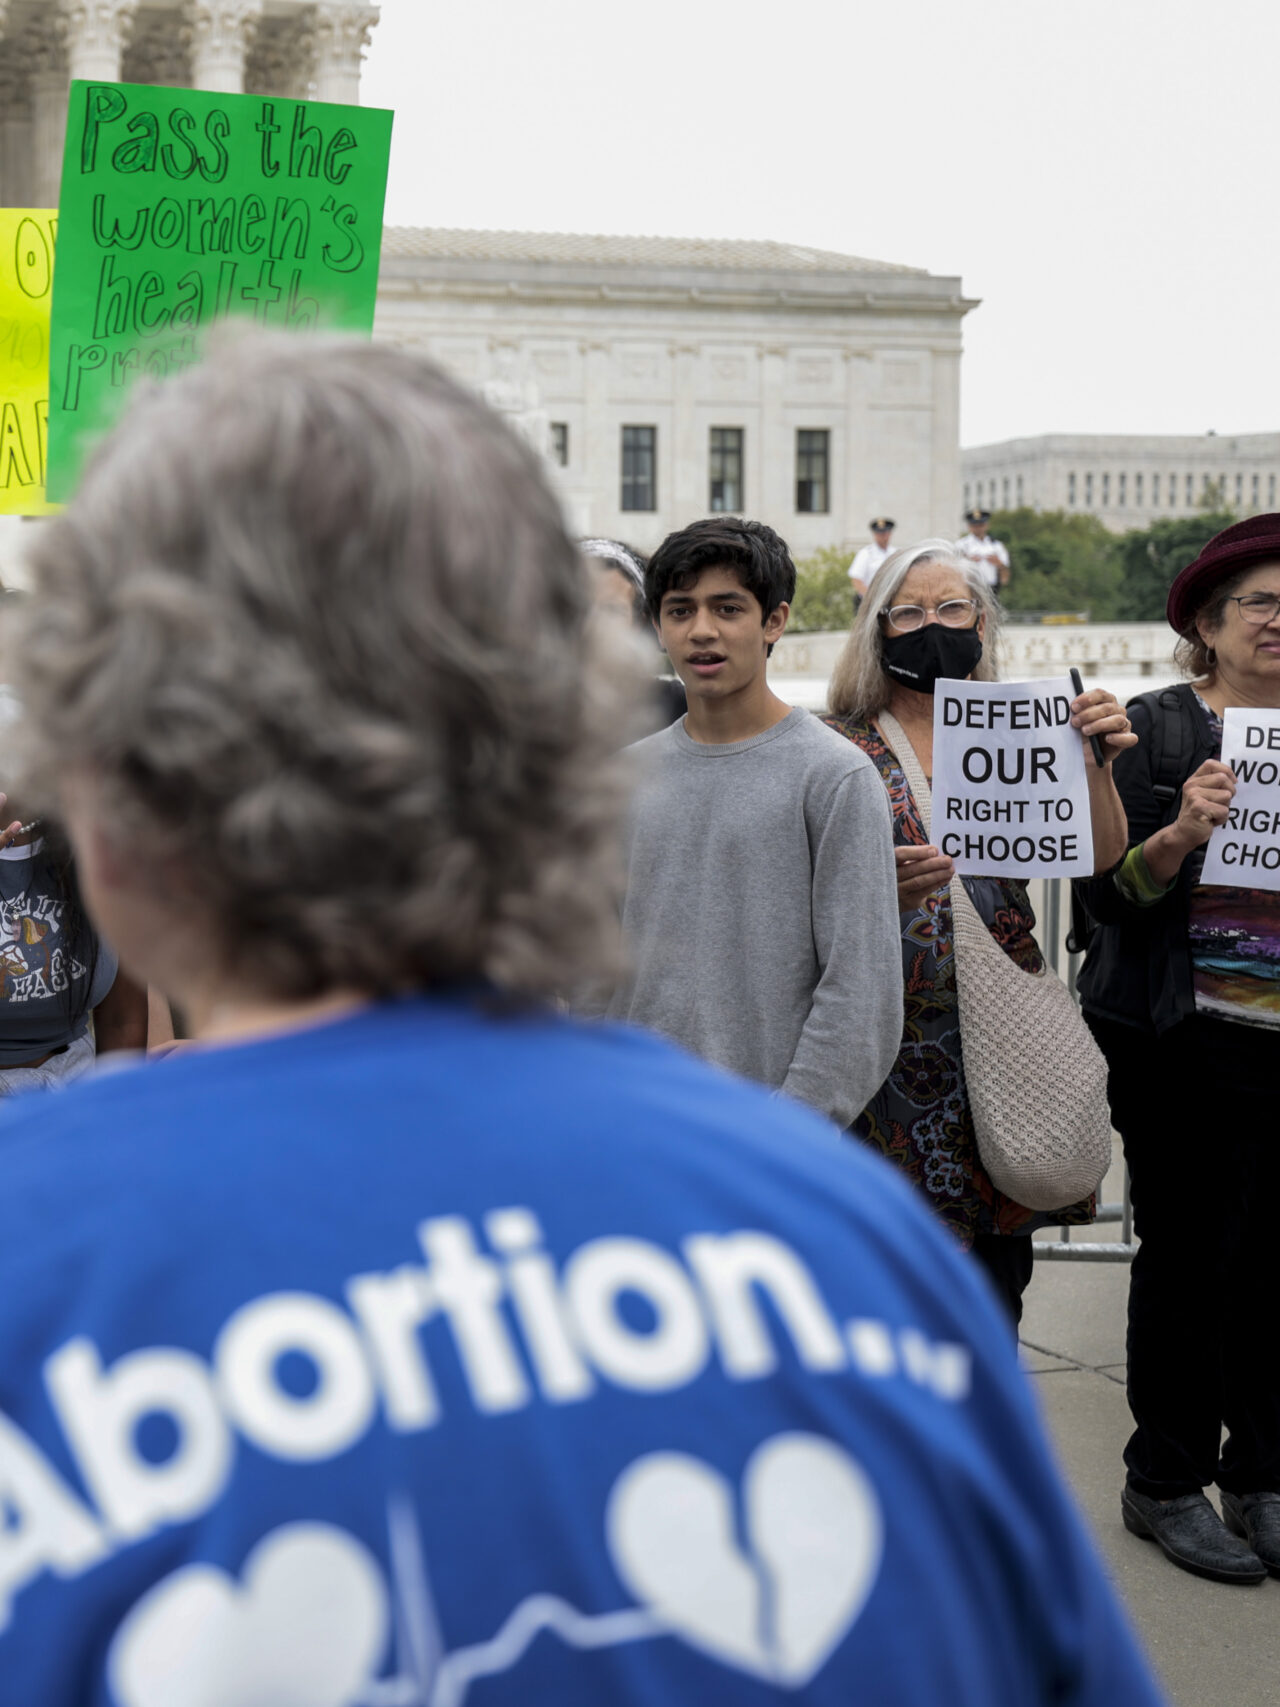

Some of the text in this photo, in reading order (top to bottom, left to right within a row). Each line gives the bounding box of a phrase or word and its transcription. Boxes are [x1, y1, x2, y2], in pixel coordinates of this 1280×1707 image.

[80, 86, 358, 185] Pass the
[91, 193, 365, 273] women's
[92, 254, 320, 339] health
[62, 335, 204, 411] prot
[942, 695, 1070, 730] DEFEND
[962, 746, 1059, 785] OUR
[1230, 759, 1280, 786] WO
[946, 797, 1074, 823] RIGHT TO
[941, 832, 1079, 863] CHOOSE
